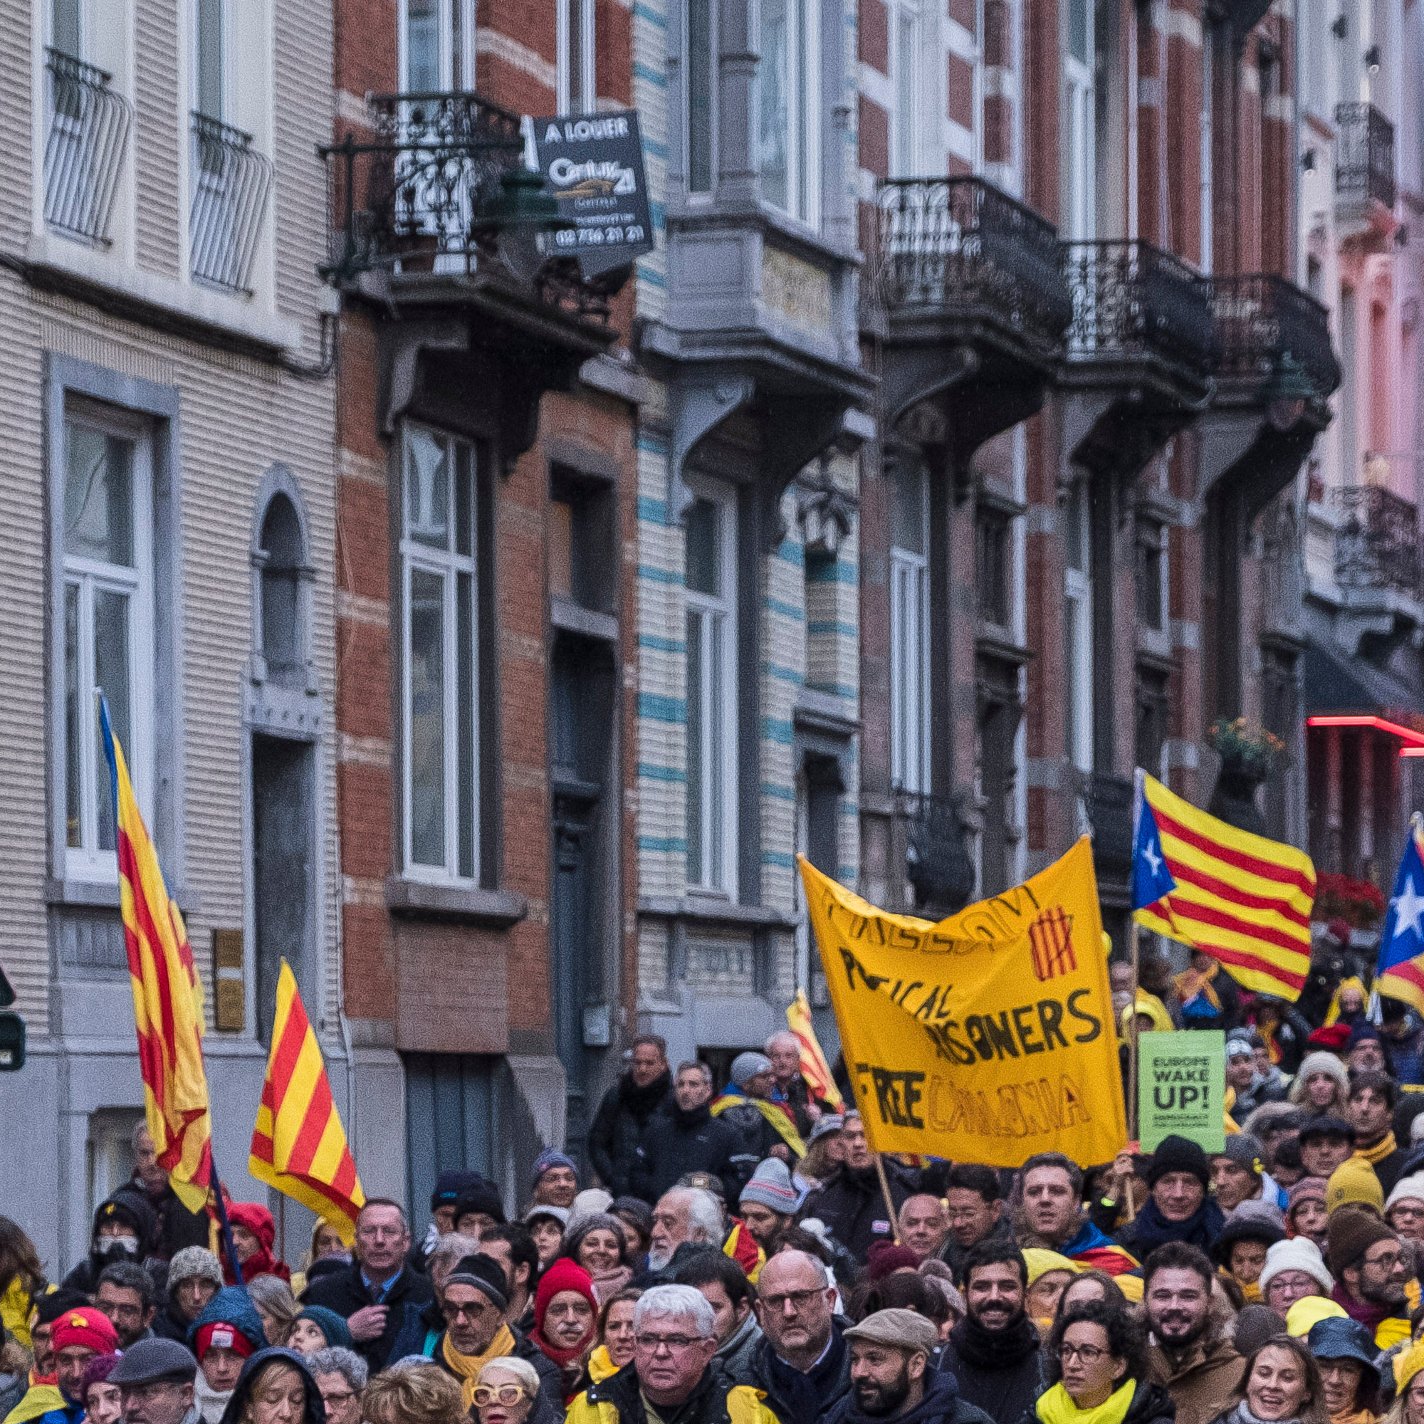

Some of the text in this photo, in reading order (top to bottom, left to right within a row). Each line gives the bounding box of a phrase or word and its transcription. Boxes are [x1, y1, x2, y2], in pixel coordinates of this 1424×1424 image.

[922, 988, 1102, 1065] ISONERS
[1153, 1070, 1209, 1082] WAKE
[1153, 1085, 1209, 1110] UP!
